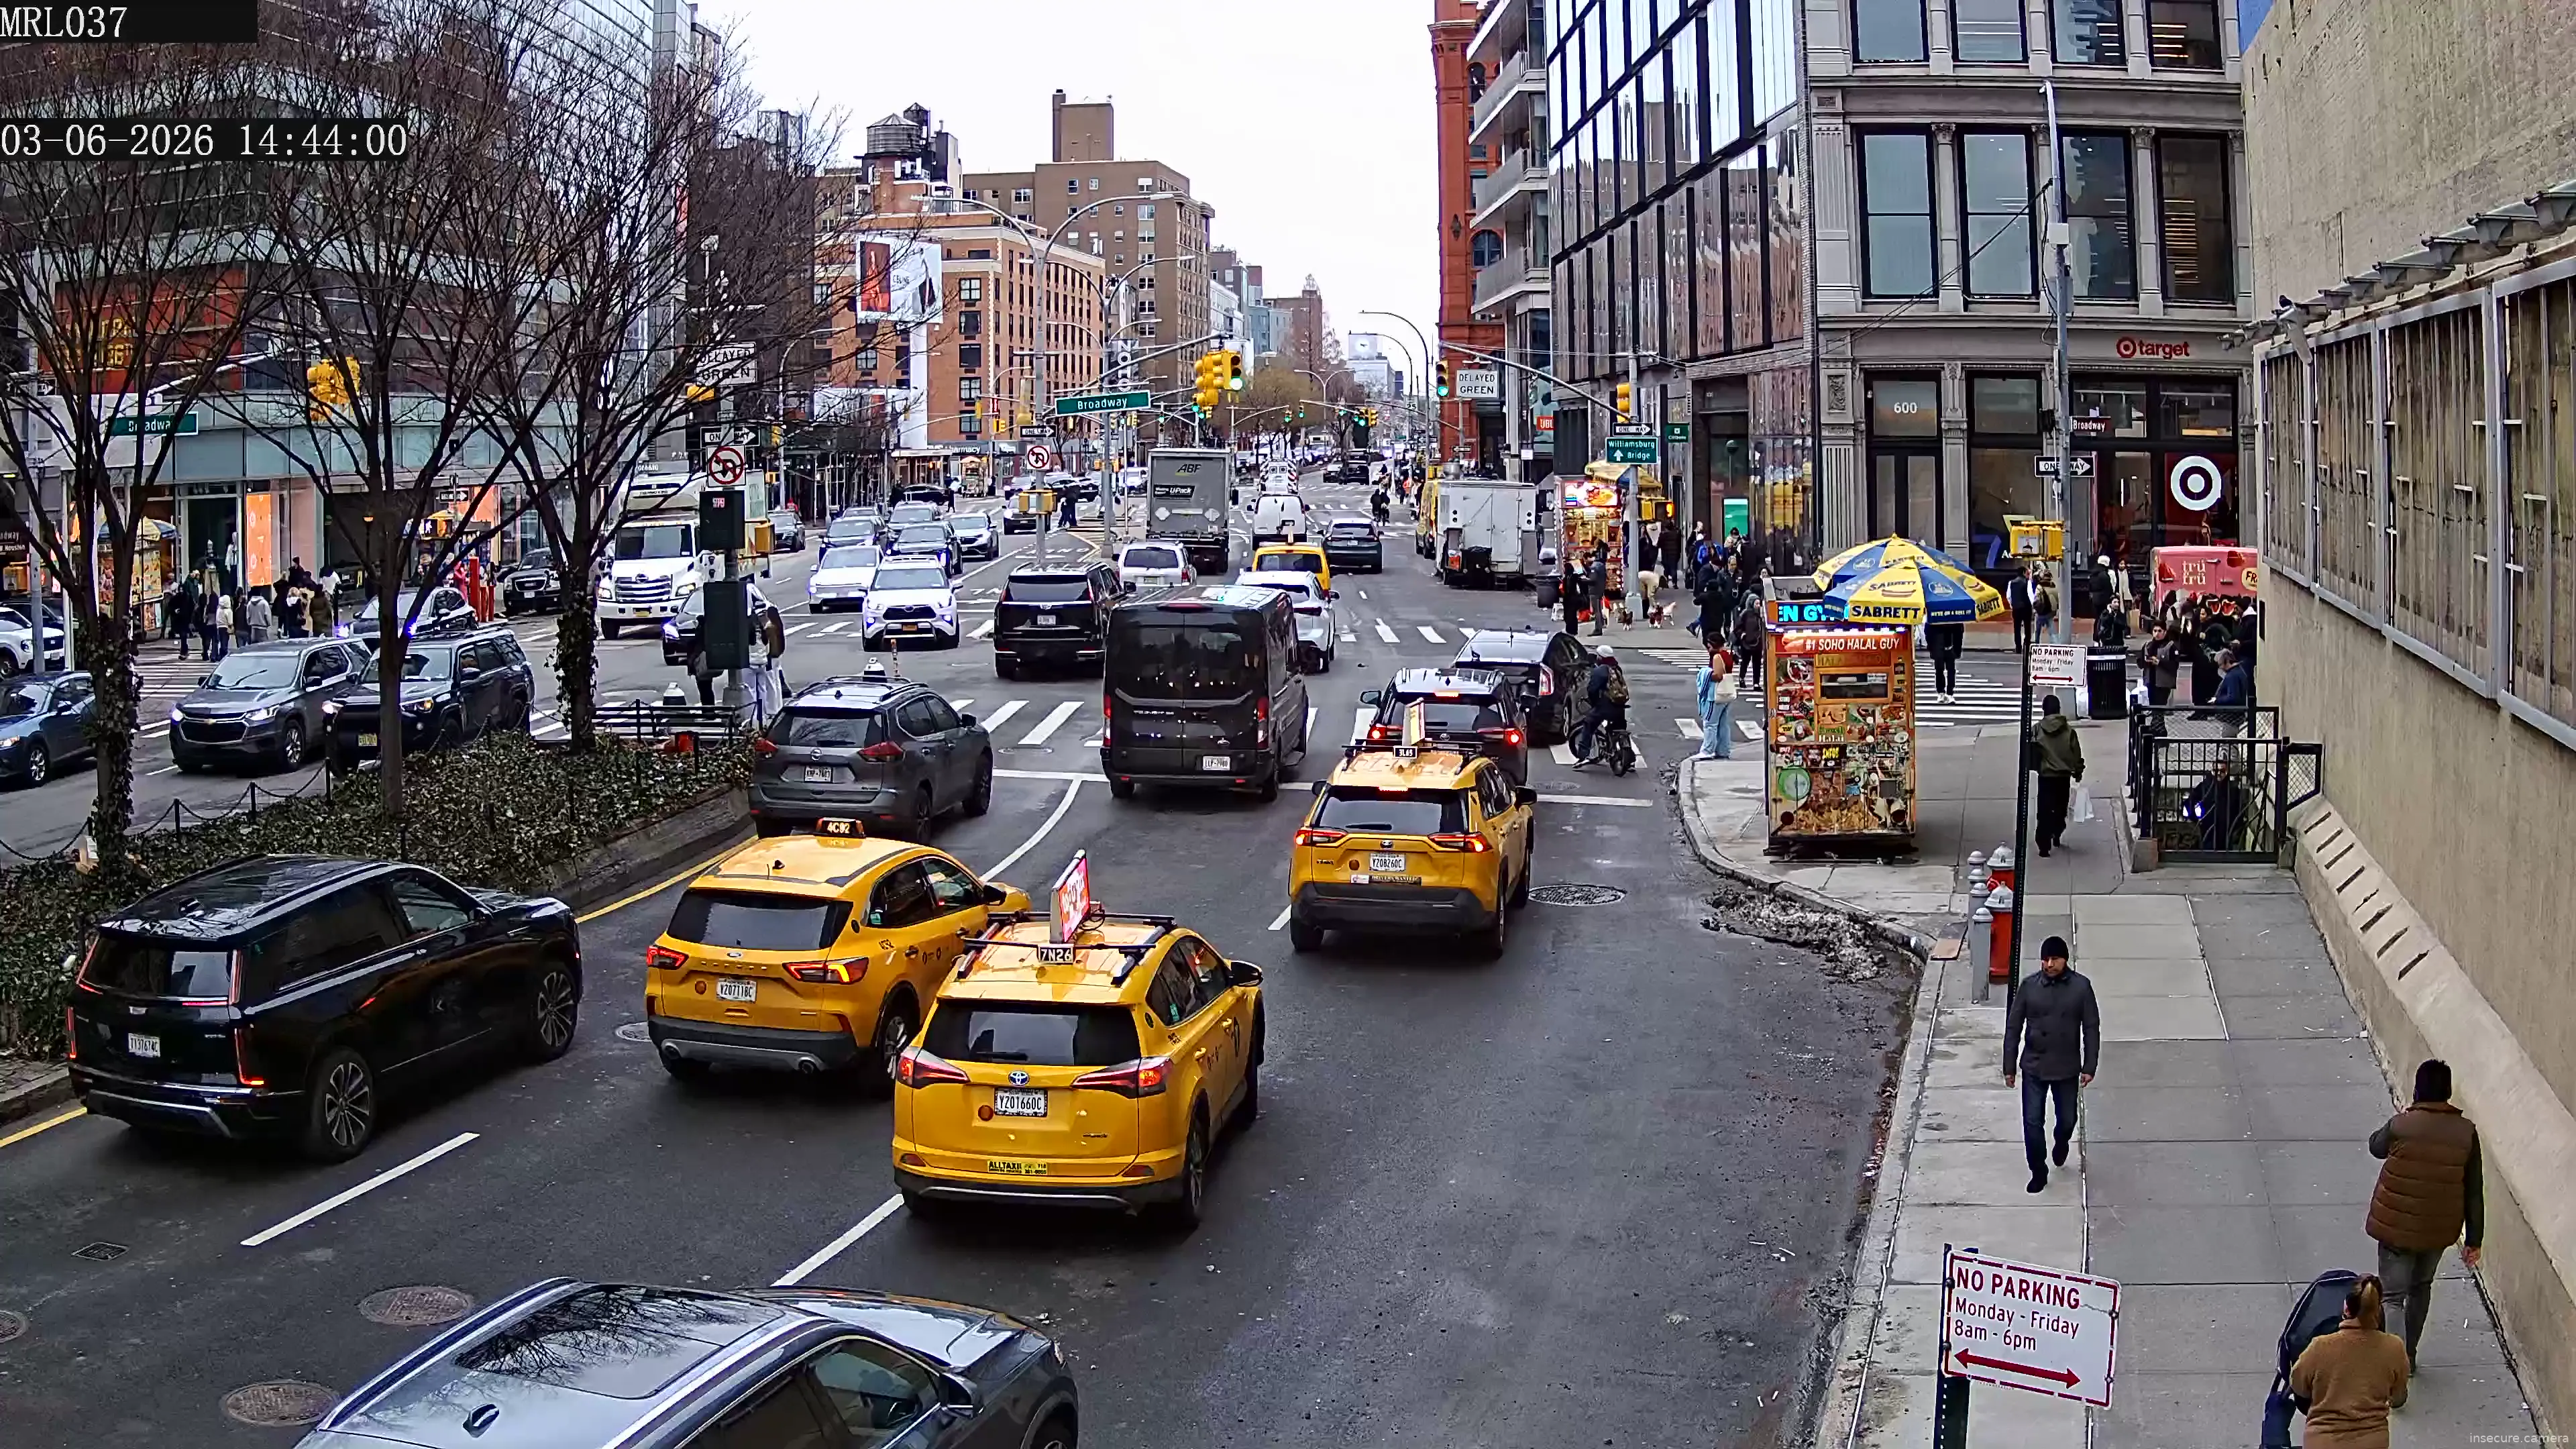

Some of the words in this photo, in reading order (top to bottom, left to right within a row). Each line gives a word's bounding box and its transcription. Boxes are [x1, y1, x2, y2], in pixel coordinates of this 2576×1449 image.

[701, 350, 750, 363] DELAYED
[2138, 341, 2190, 360] target
[1118, 340, 1131, 392] NOHO
[1459, 374, 1495, 382] DELAYED
[1460, 386, 1494, 394] GREEN
[1077, 397, 1128, 409] Broadway
[1894, 402, 1918, 413] 600
[2074, 420, 2106, 432] Broadway
[709, 433, 722, 441] ON
[1609, 440, 1655, 449] Williamsburg
[1627, 451, 1650, 461] Bridge
[1176, 464, 1202, 473] ABF
[2043, 461, 2061, 470] ONE
[2182, 558, 2206, 573] trü
[2245, 570, 2258, 584] FR
[1869, 580, 1917, 591] SABRETT
[1851, 606, 1921, 619] SABRETT
[1805, 639, 1815, 650] #1
[1819, 638, 1845, 650] SOHO
[1847, 638, 1877, 650] HALAL
[1880, 638, 1900, 649] GUY
[2044, 648, 2074, 657] PARKING
[826, 821, 851, 833] 4C92
[1040, 949, 1072, 962] 7N26
[1000, 1095, 1042, 1111] Y201660C
[1957, 1267, 1984, 1292] NO
[1991, 1273, 2080, 1309] PARKING
[1955, 1296, 2015, 1328] Monday
[2031, 1310, 2080, 1340] Friday
[1954, 1319, 1987, 1341] 8am
[2003, 1328, 2037, 1351] 6pm
